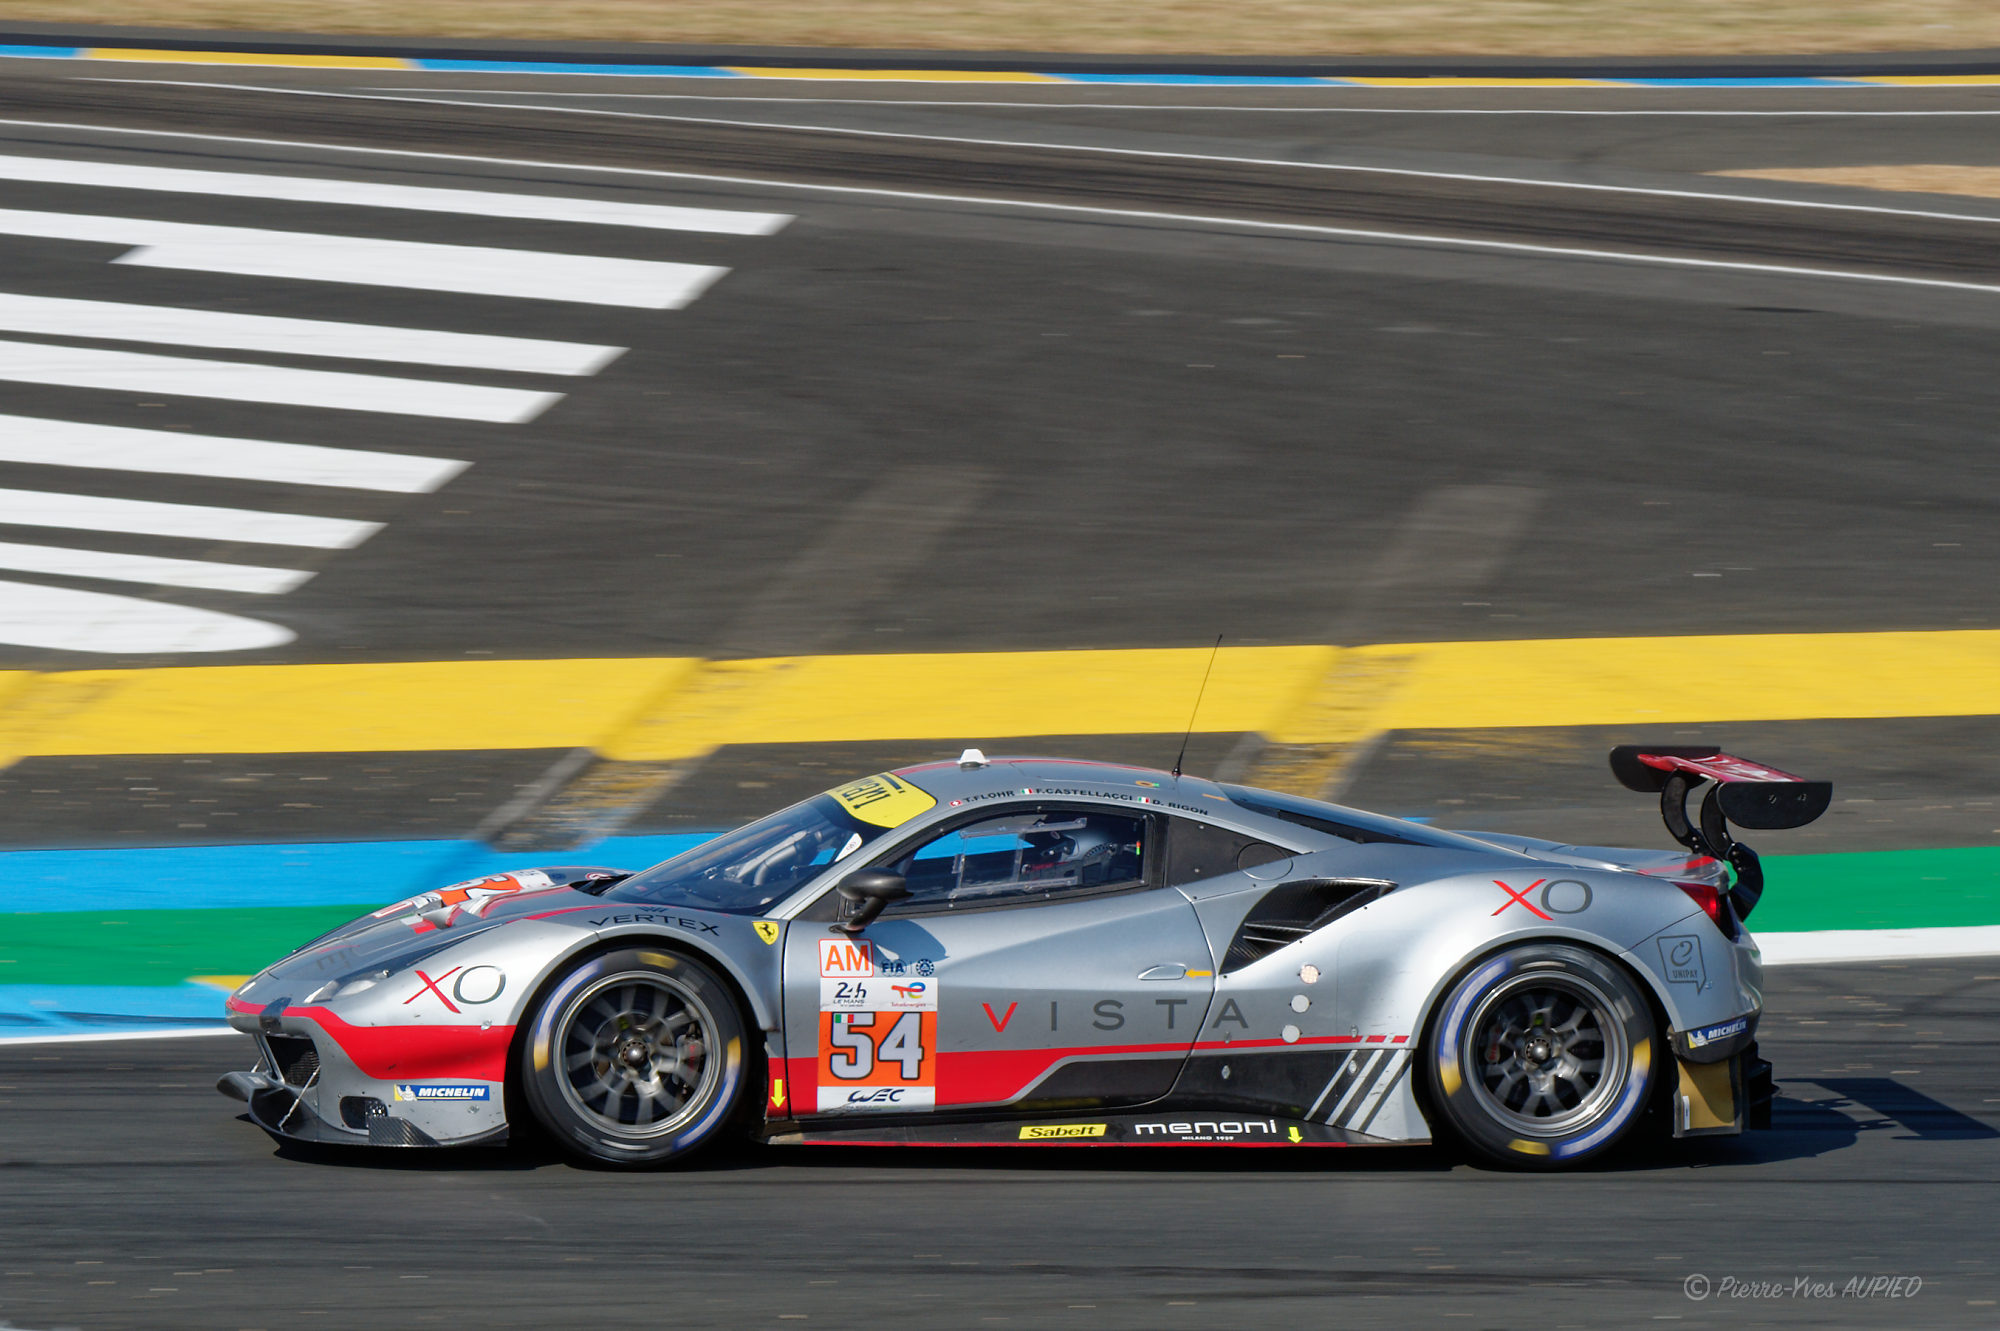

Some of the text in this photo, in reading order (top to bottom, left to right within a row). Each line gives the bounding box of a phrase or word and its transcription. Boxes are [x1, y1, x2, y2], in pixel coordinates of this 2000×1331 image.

[964, 790, 1015, 803] T.FLOHR
[1035, 788, 1133, 801] F.CASTELLACCI
[1168, 802, 1208, 815] RIGON
[1490, 878, 1593, 921] XO
[588, 914, 720, 936] VERTEX
[825, 945, 869, 971] AM
[882, 962, 904, 973] FIA
[1672, 969, 1698, 979] UNIPAY
[402, 965, 506, 1014] XO
[982, 998, 1248, 1033] VISTA
[1707, 1020, 1747, 1039] MICHELIN
[830, 1011, 925, 1080] 54
[418, 1087, 485, 1097] MICHELIN
[847, 1088, 905, 1102] WEC
[1029, 1126, 1096, 1138] Sabelt
[1135, 1119, 1277, 1135] menoni
